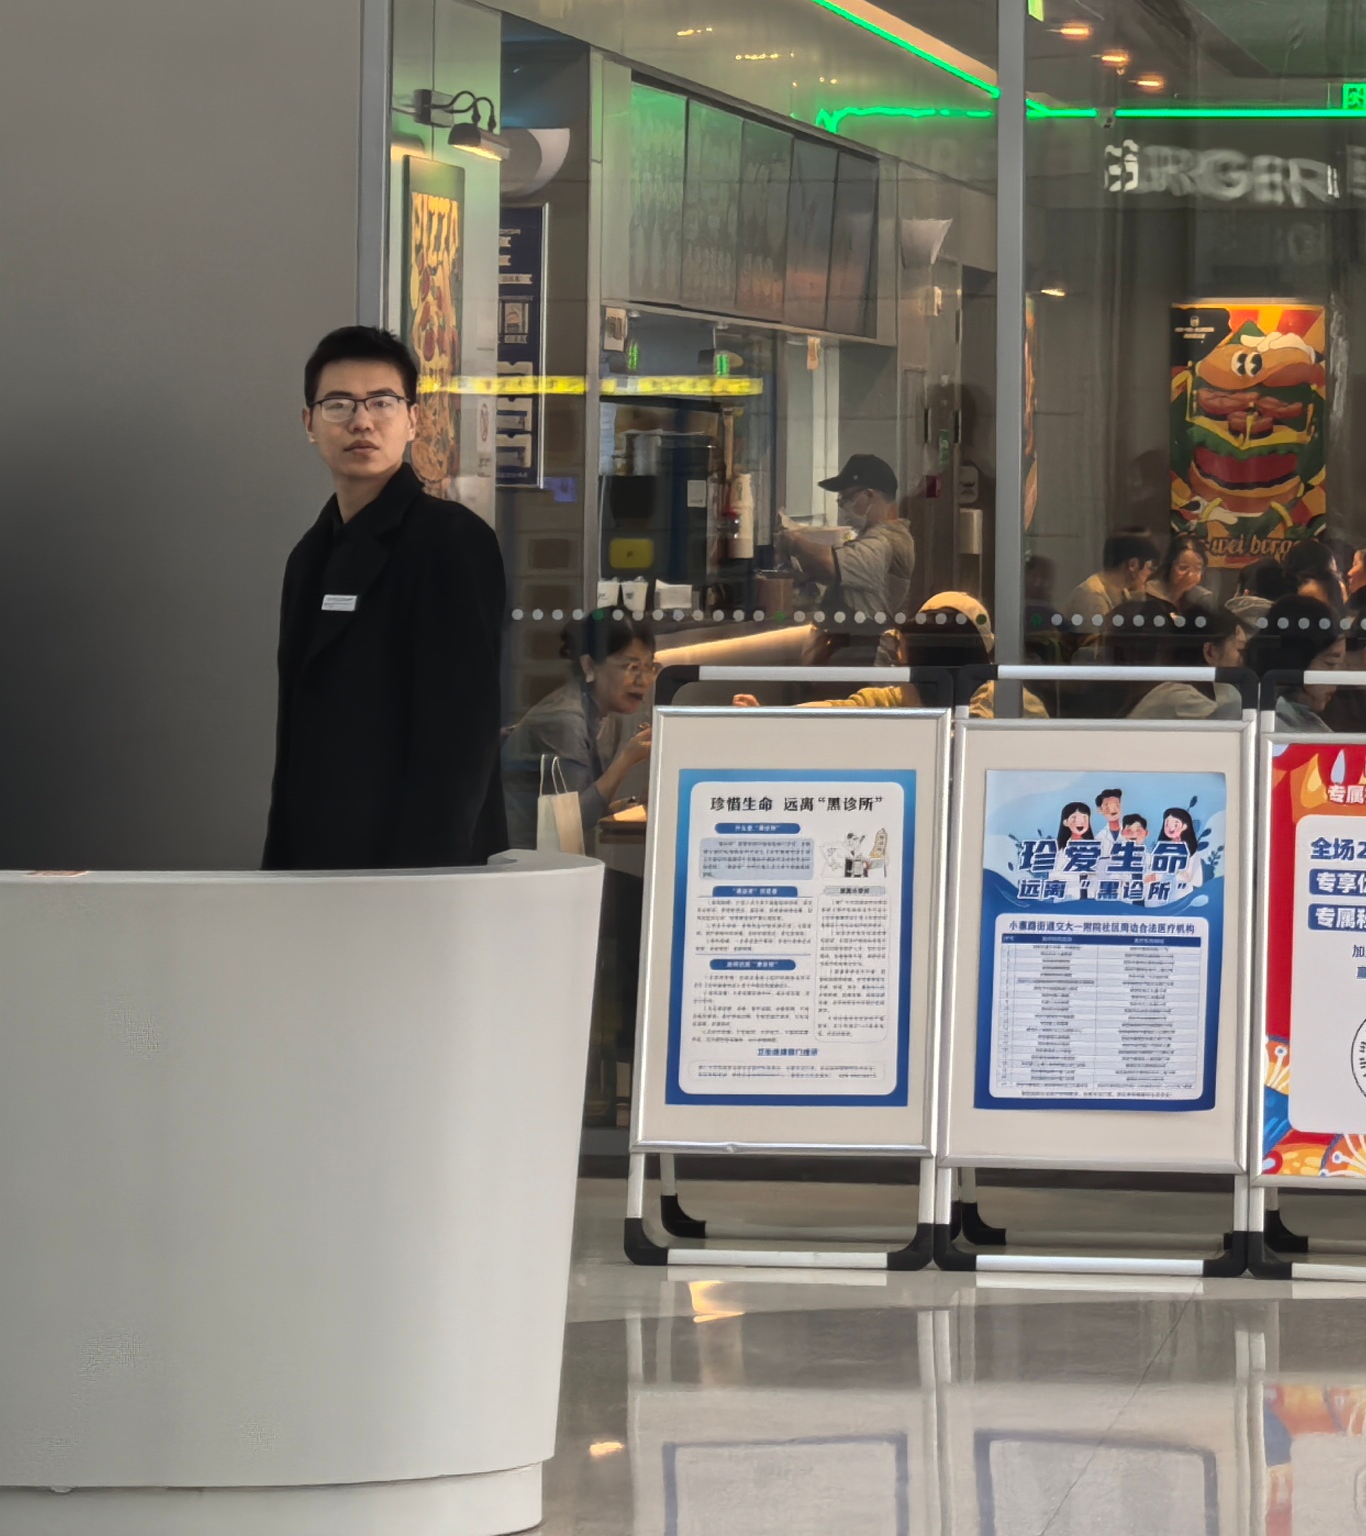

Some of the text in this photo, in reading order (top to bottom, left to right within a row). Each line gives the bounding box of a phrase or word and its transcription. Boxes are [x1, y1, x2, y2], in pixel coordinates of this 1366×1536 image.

[710, 797, 773, 812] 珍惜生命
[1019, 840, 1190, 873] 珍爱生命
